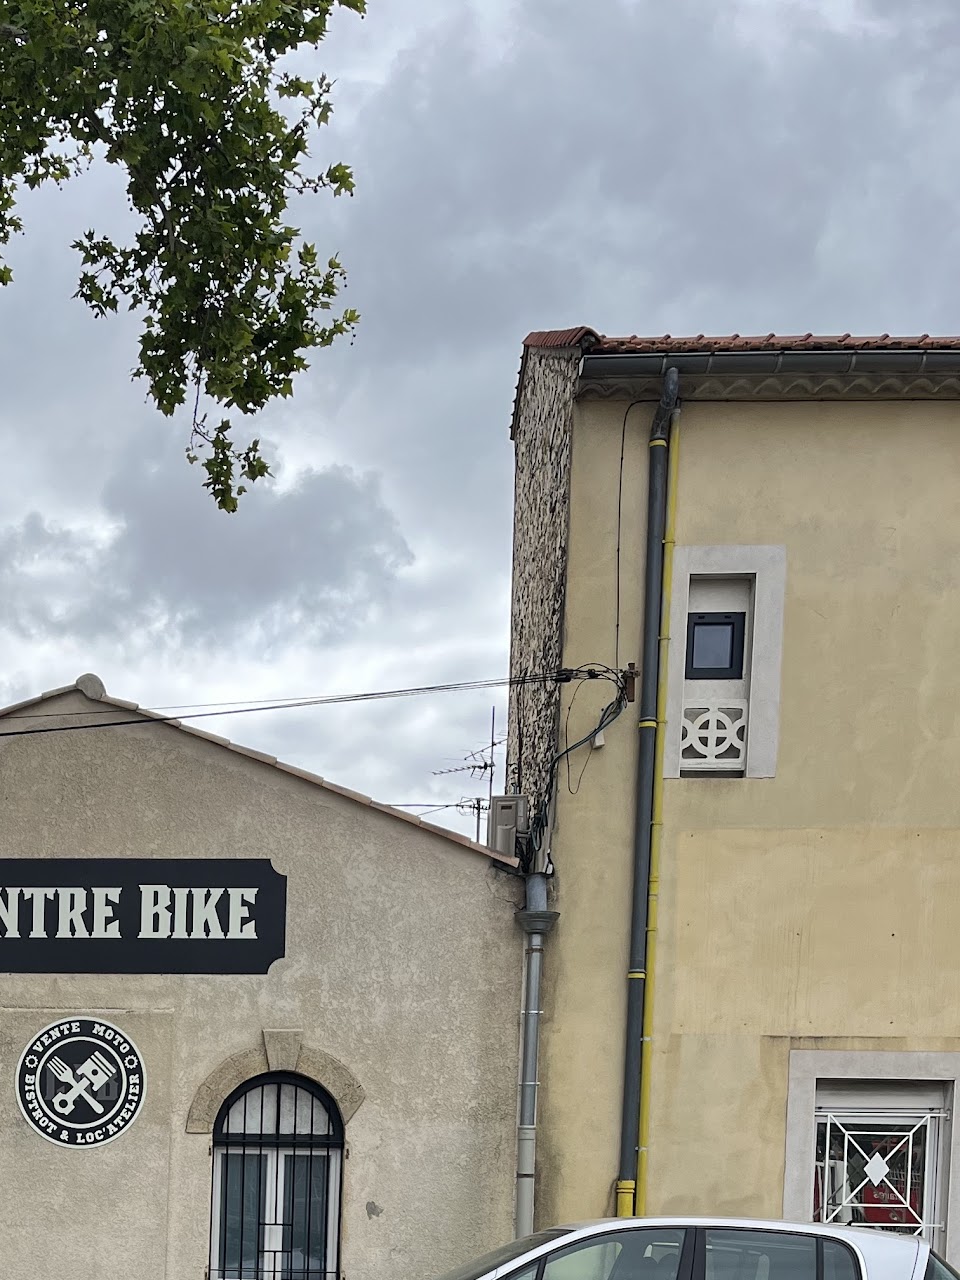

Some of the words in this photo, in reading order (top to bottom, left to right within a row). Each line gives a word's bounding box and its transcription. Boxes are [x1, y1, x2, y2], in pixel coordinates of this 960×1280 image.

[137, 884, 259, 939] BIKE
[32, 1022, 80, 1052] VENTE
[92, 1023, 130, 1053] MOTO
[25, 1074, 58, 1133] BISTROT
[60, 1129, 69, 1141] &
[76, 1074, 140, 1143] LOC'ATELIER
